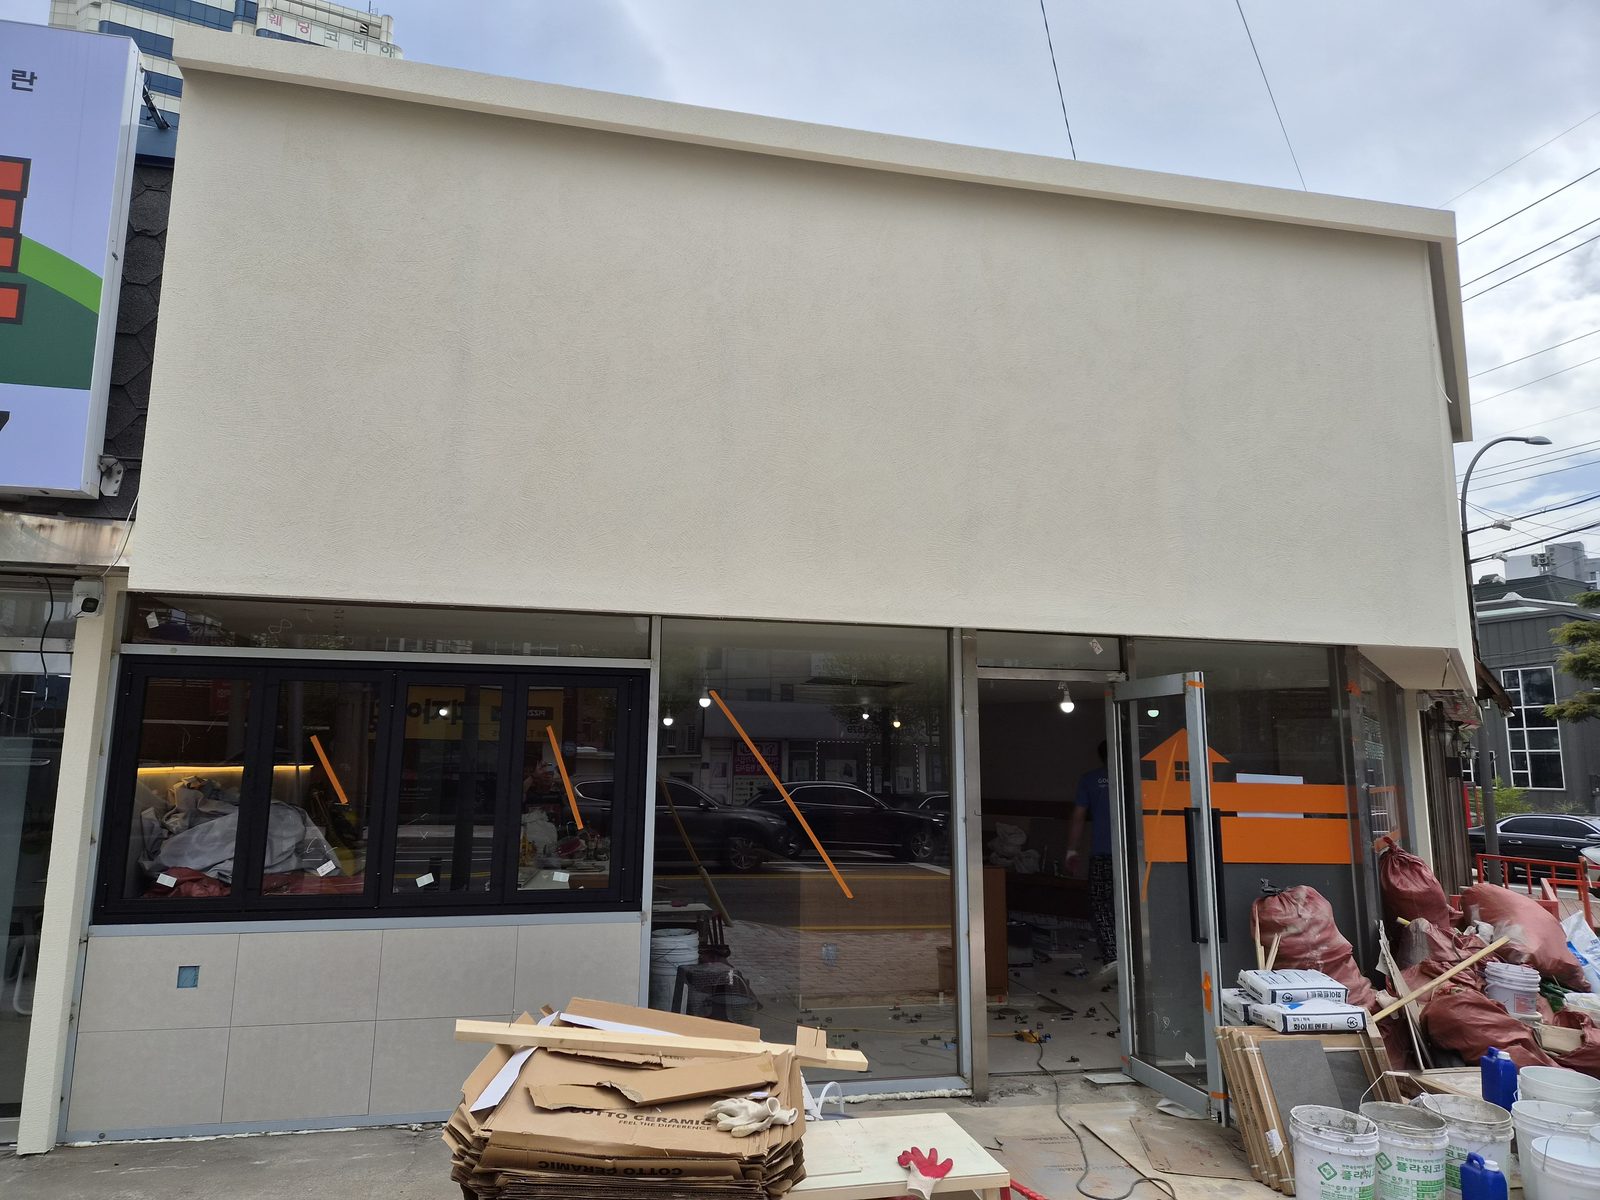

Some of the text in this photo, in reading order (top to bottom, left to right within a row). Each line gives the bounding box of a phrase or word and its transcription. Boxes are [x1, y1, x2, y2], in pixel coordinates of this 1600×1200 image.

[11, 69, 38, 92] 란
[618, 1119, 638, 1127] FEEL
[657, 1123, 713, 1131] DIFFERENCE
[633, 1114, 713, 1126] CERAMIC
[537, 1160, 684, 1176] COTTO CERAMIC
